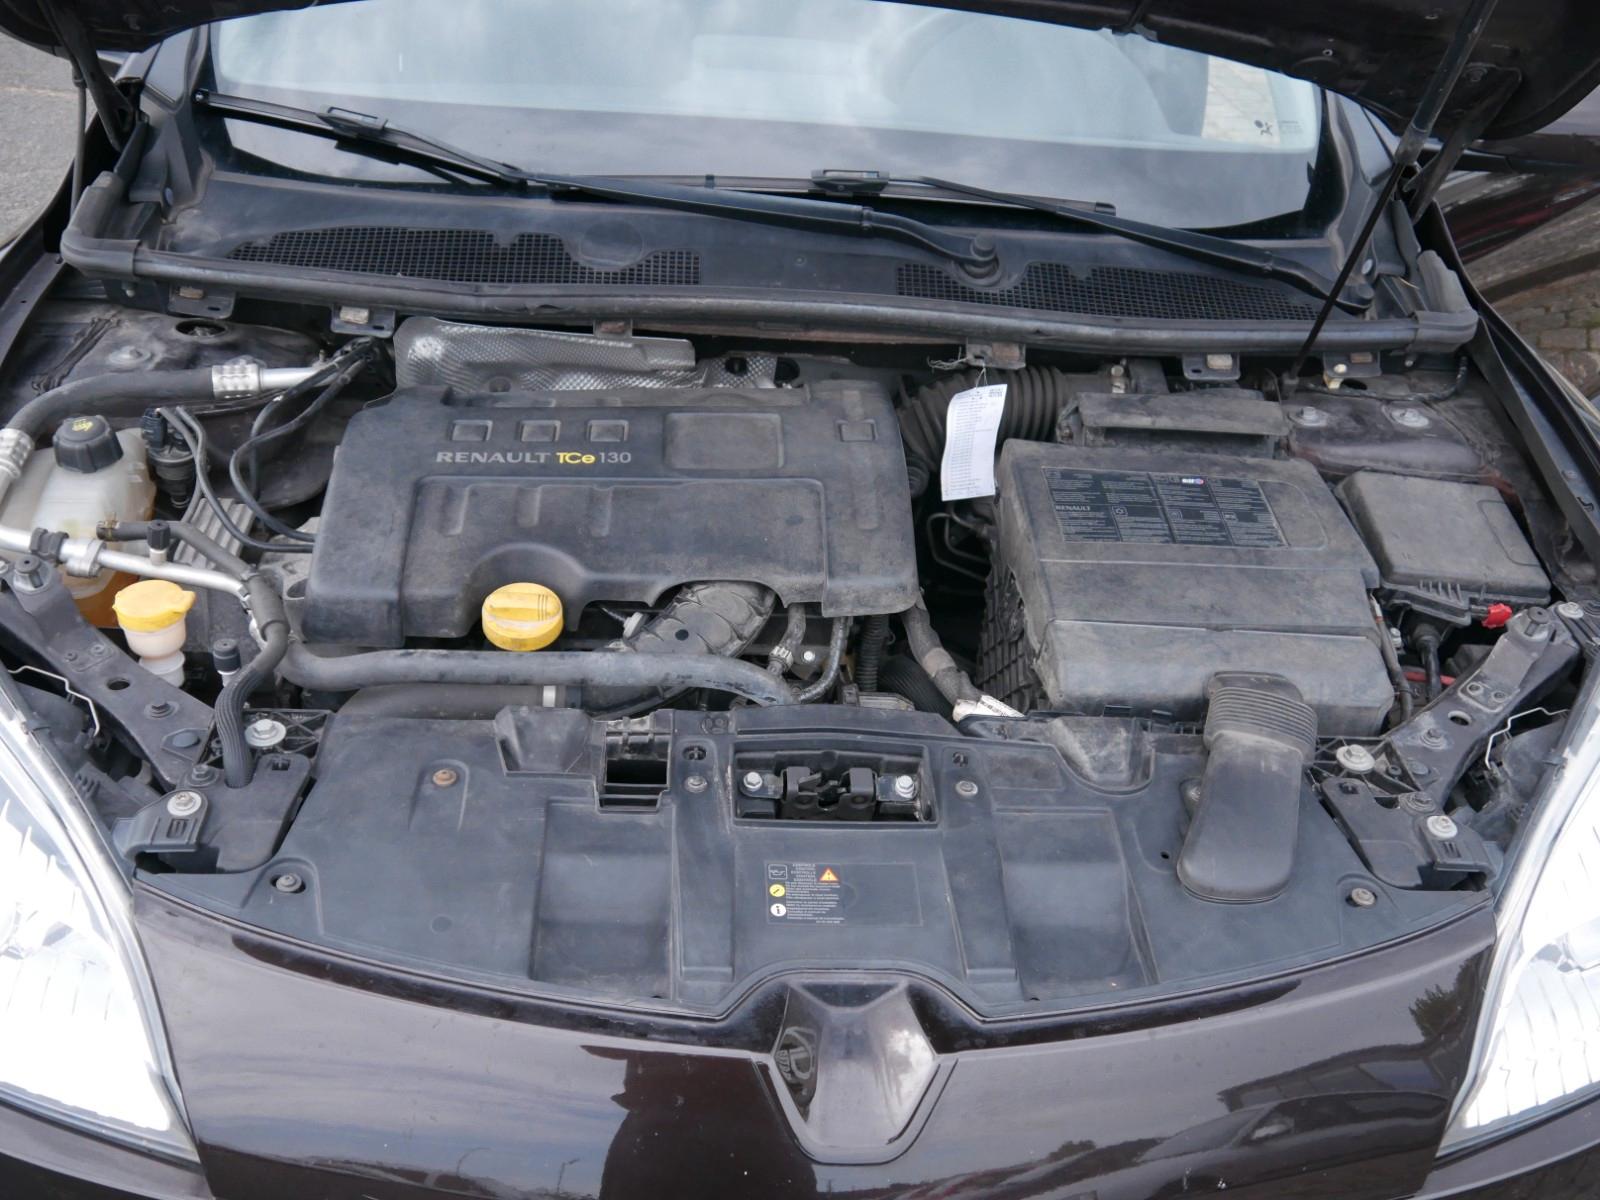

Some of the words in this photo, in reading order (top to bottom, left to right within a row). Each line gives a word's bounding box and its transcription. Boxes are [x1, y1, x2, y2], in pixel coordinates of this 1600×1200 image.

[435, 451, 550, 464] RENAULT
[555, 451, 596, 464] TCe
[600, 451, 632, 464] 130
[1055, 504, 1091, 512] RENAULT
